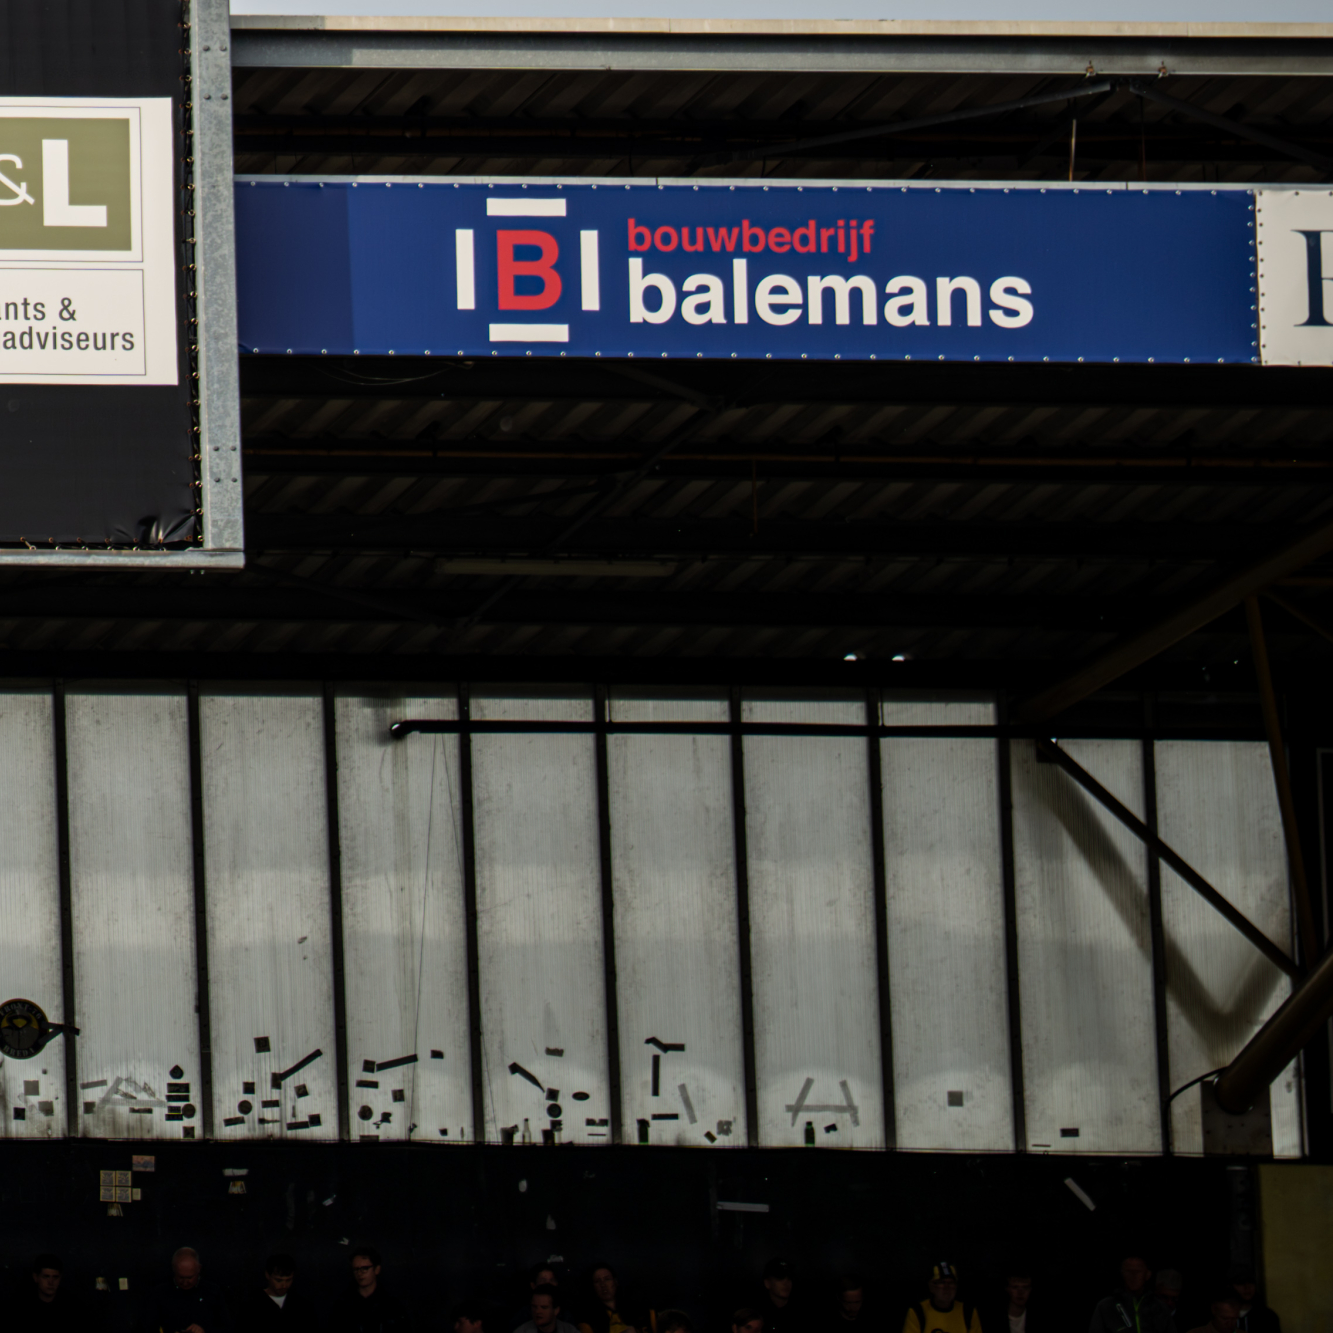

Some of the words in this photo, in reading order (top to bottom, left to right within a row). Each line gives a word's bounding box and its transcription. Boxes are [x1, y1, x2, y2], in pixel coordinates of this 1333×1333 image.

[627, 217, 875, 262] bouwbedrijf
[58, 297, 77, 322] &
[627, 257, 1035, 328] balemans
[2, 1043, 35, 1057] BREDA
